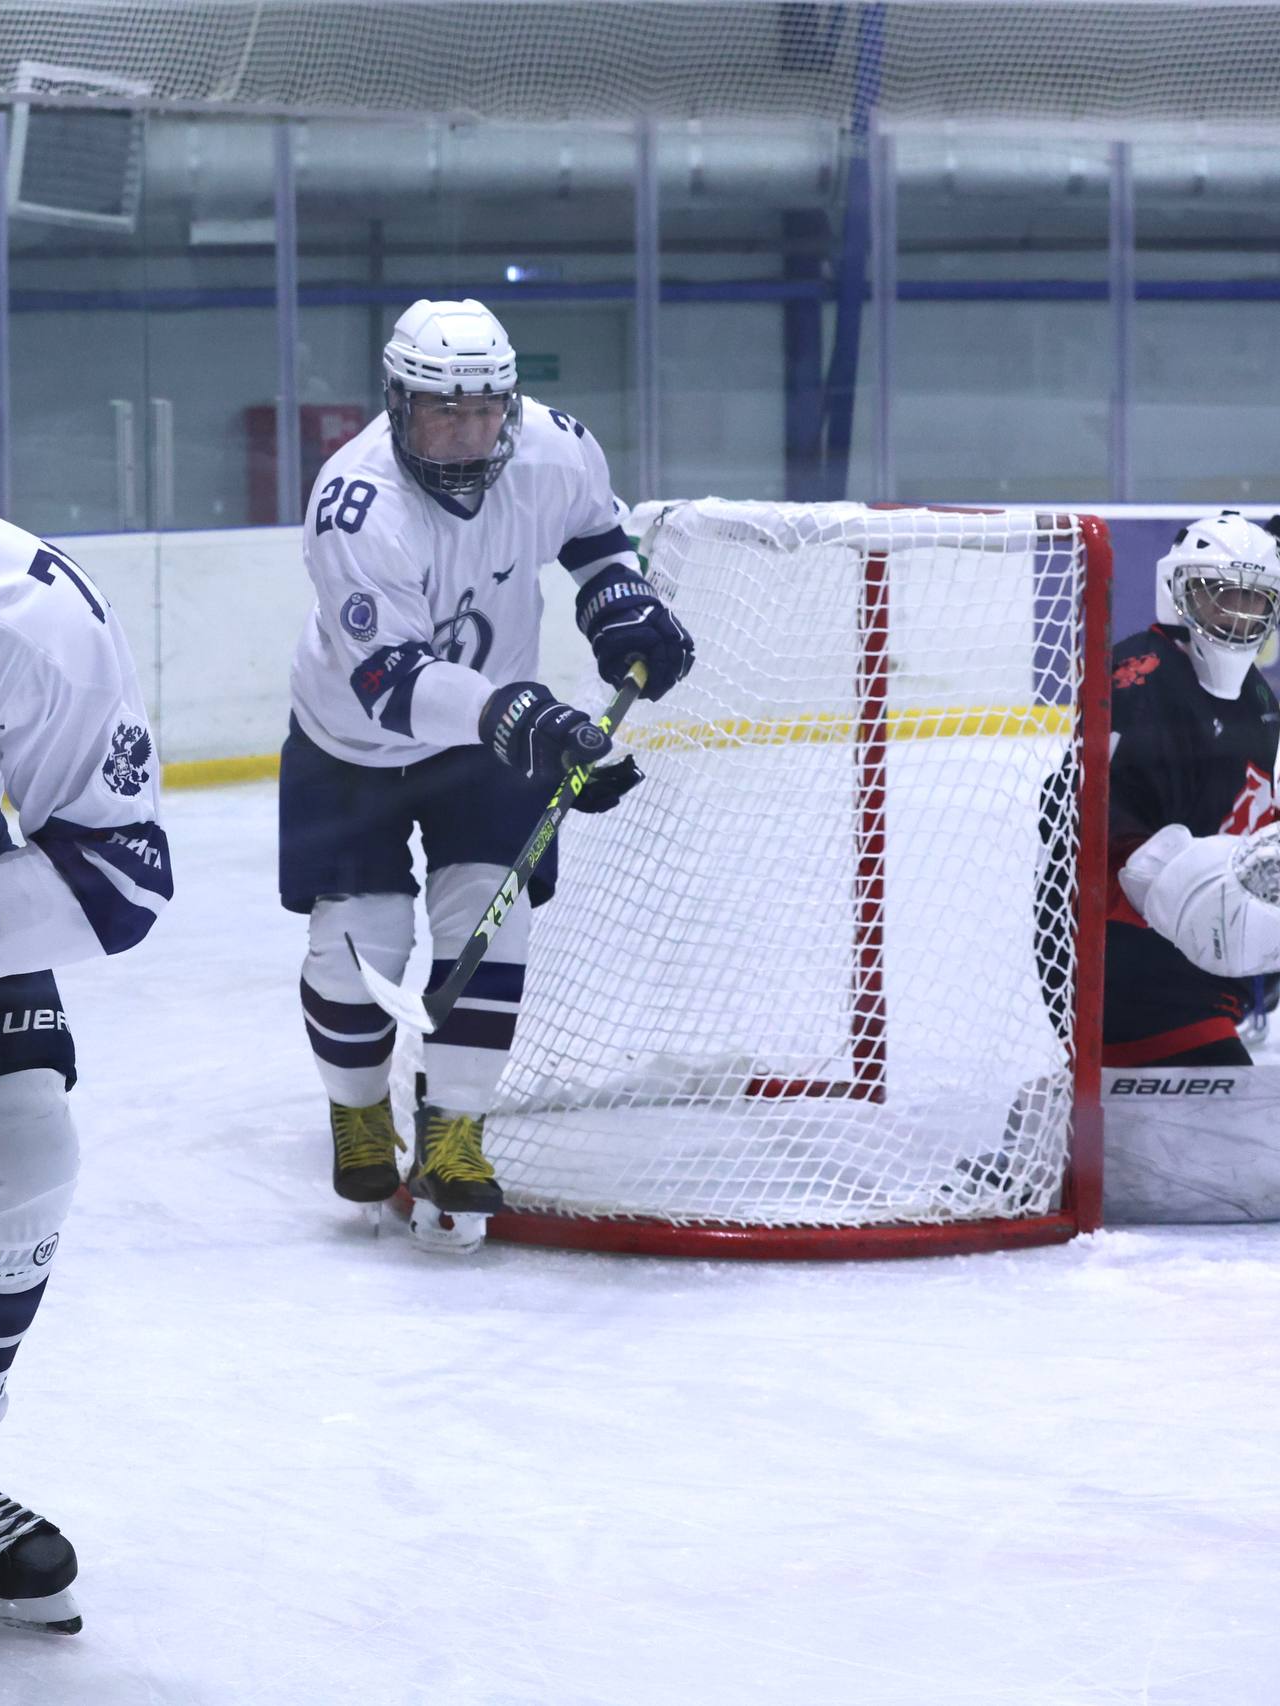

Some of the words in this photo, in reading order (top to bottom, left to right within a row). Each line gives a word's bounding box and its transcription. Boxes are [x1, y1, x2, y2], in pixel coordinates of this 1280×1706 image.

[316, 476, 378, 537] 28
[27, 540, 111, 625] 7
[1230, 560, 1266, 572] CCM
[1110, 1078, 1236, 1096] BAUER
